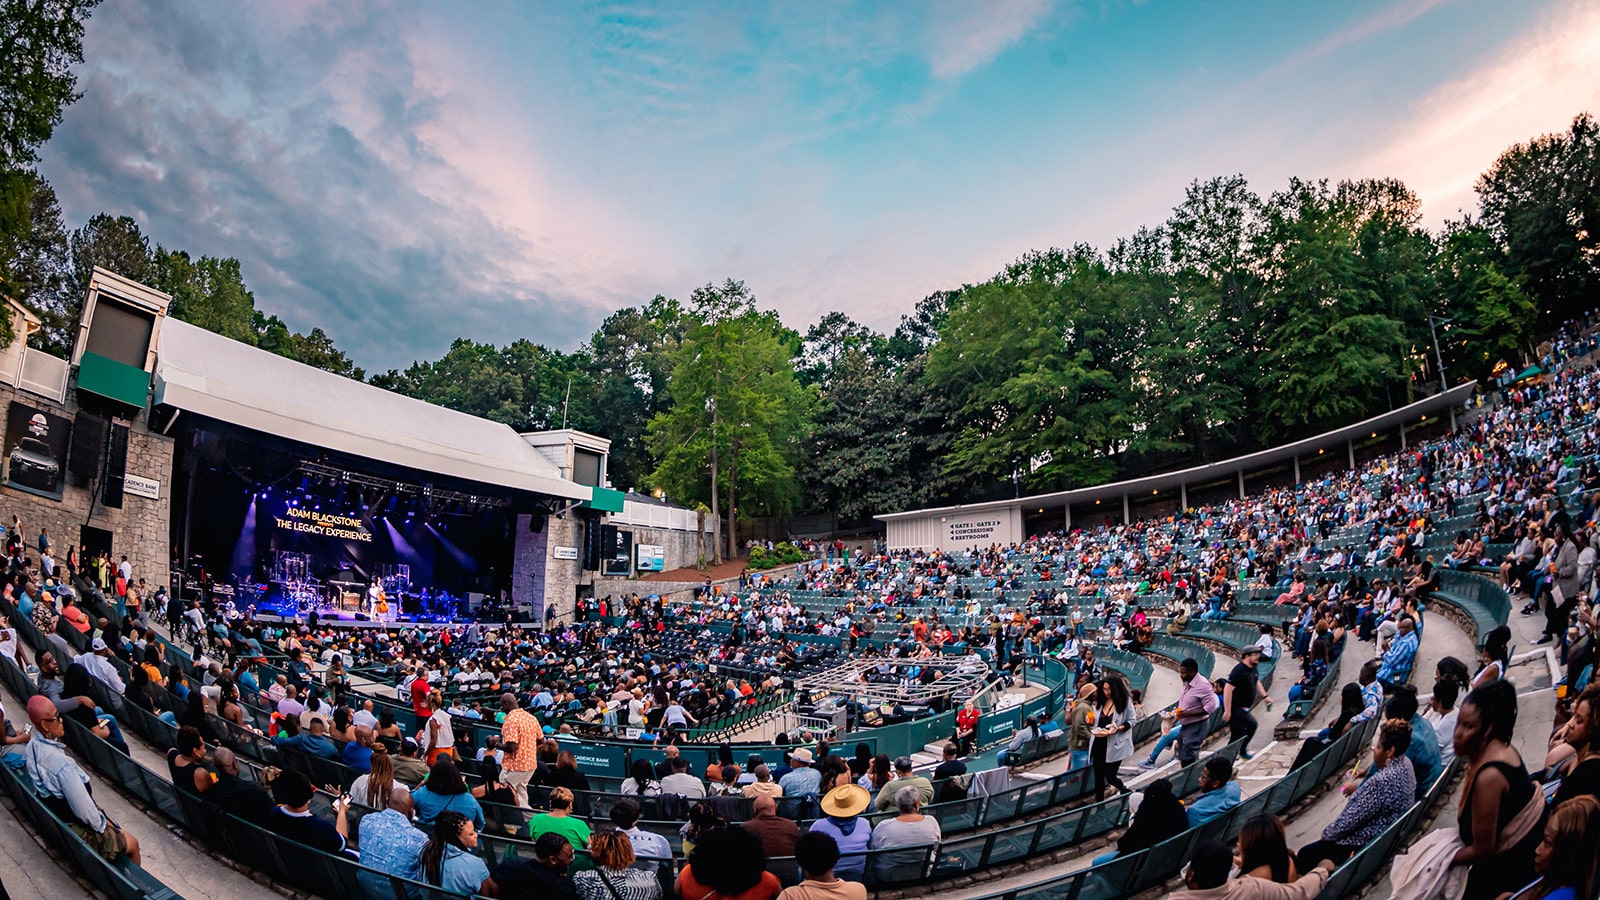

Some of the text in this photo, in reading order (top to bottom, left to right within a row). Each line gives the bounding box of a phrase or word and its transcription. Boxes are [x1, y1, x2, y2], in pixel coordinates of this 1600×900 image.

[124, 478, 145, 487] CADENCE
[286, 507, 310, 519] ADAM
[312, 511, 362, 527] BLACKSTONE
[276, 518, 292, 529] THE
[293, 522, 325, 534] LEGACY
[326, 528, 372, 542] EXPERIENCE
